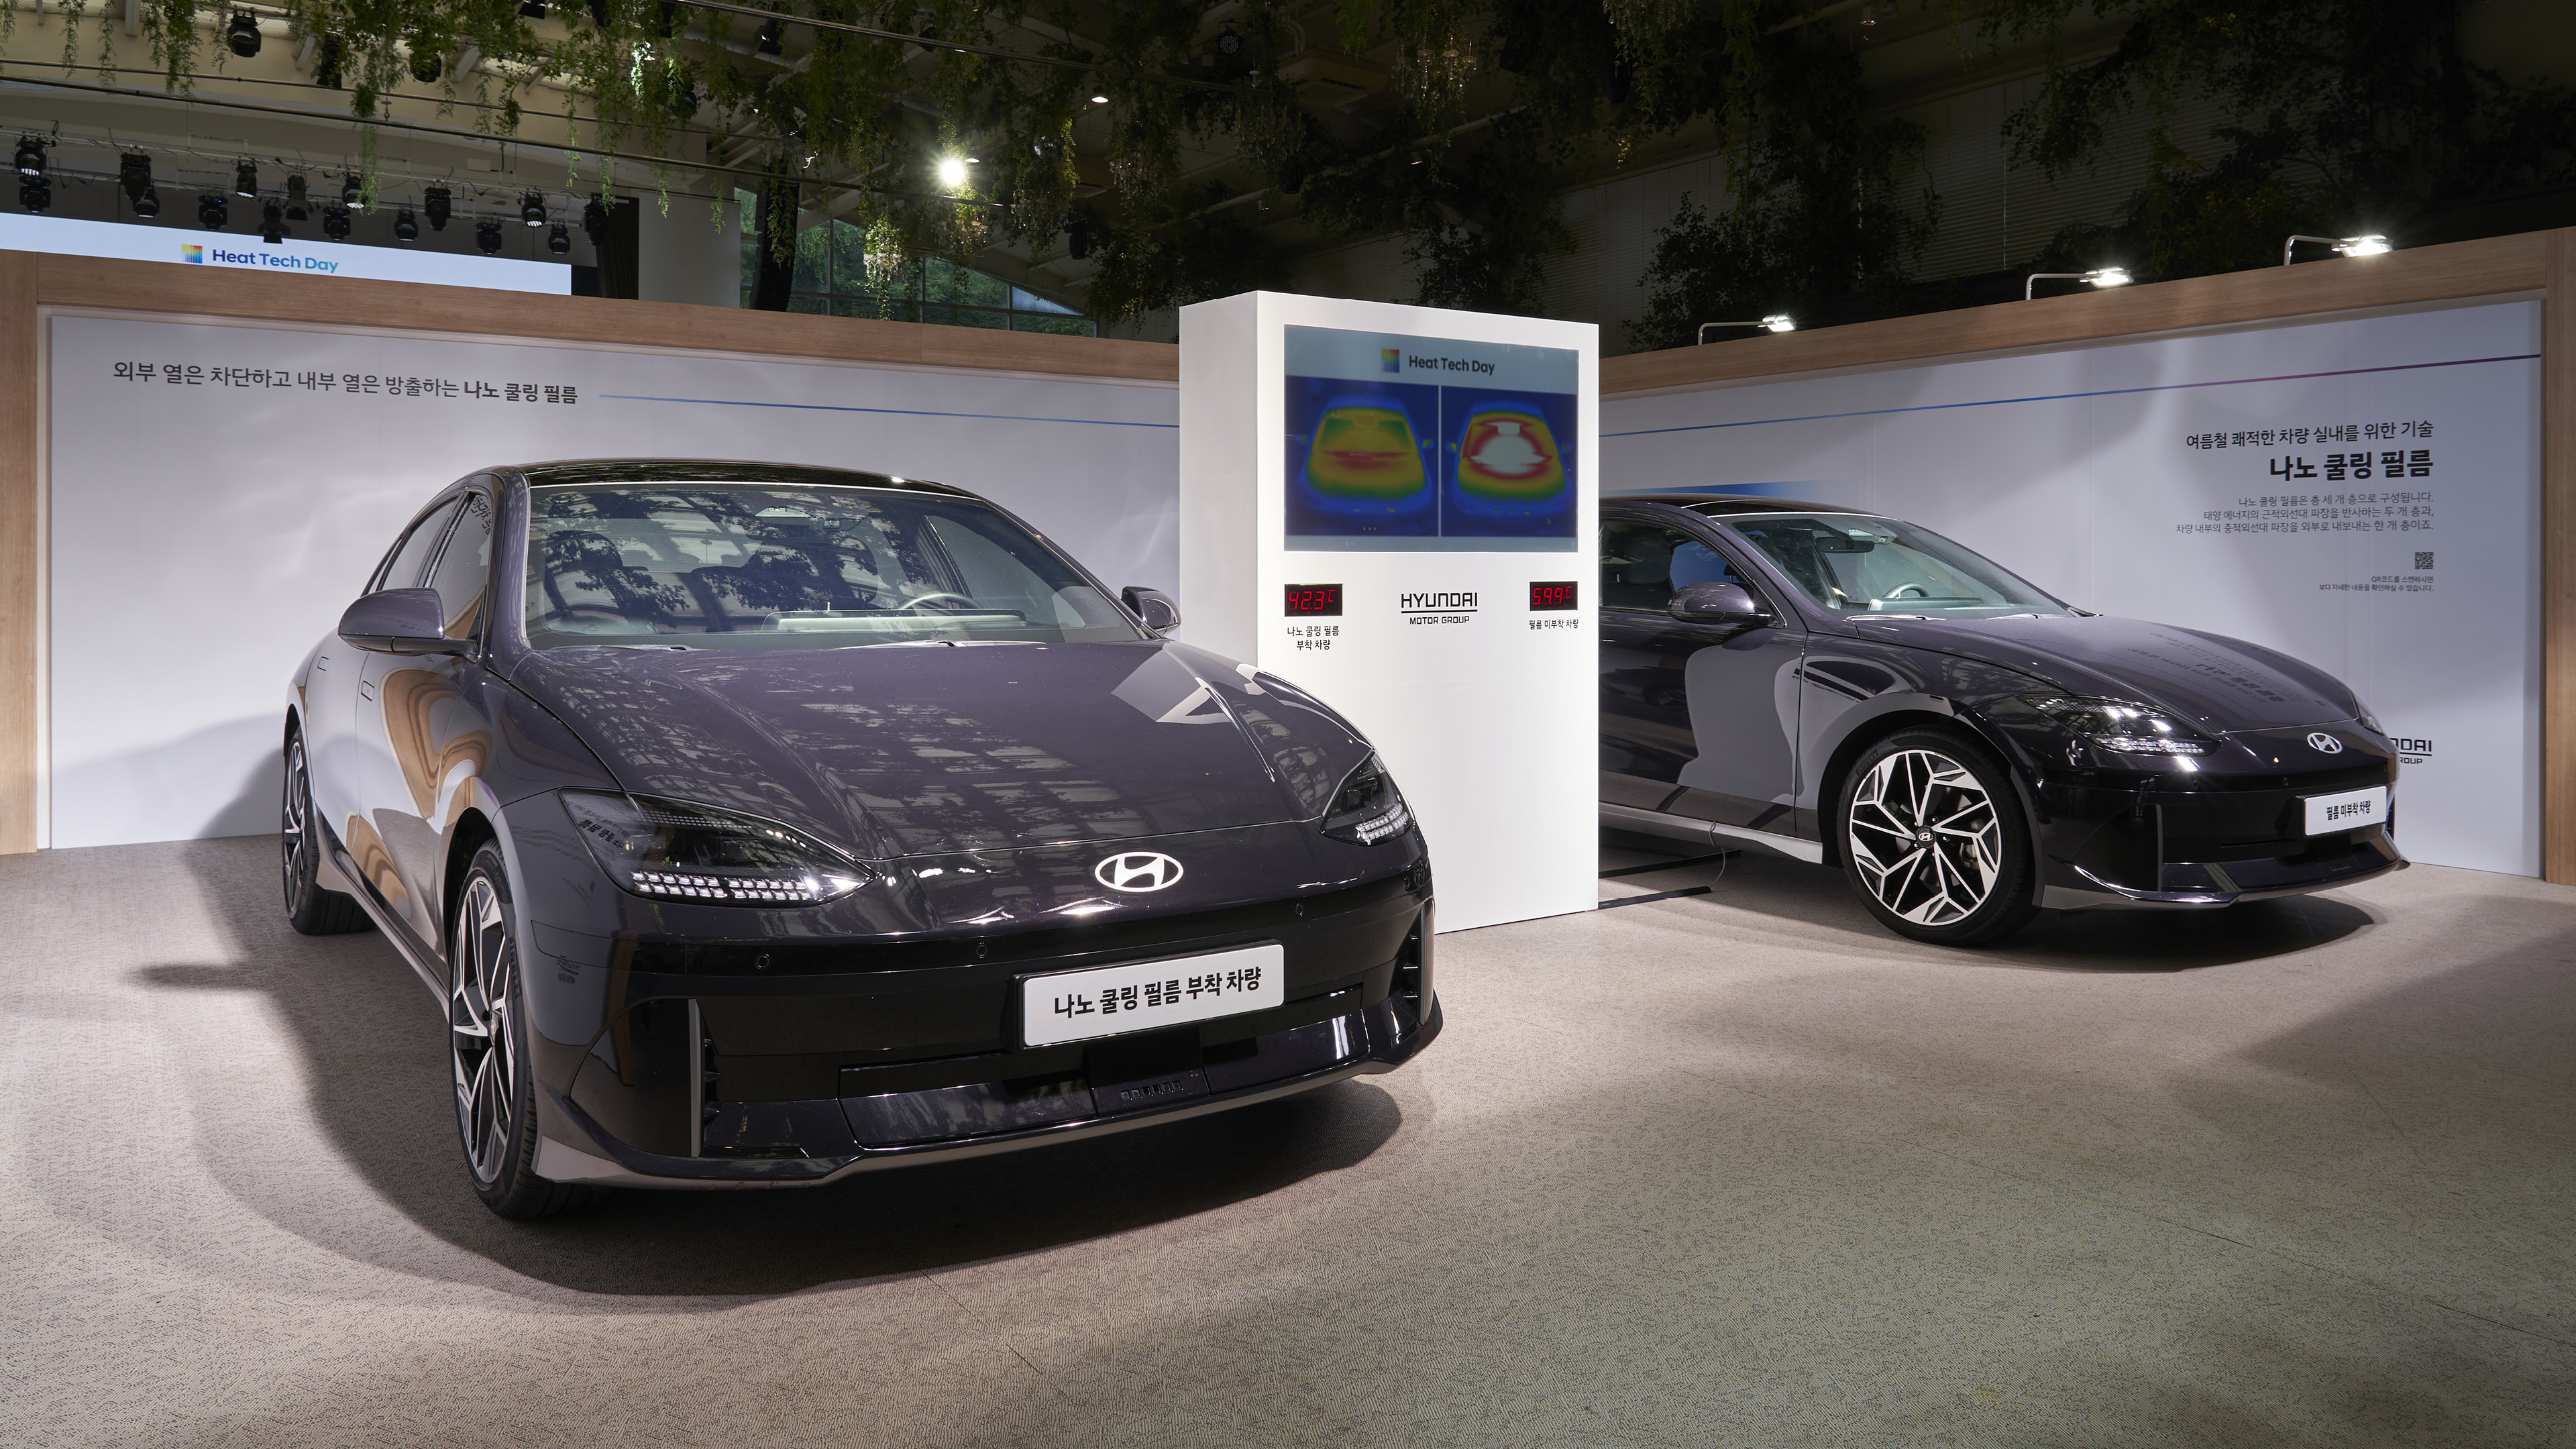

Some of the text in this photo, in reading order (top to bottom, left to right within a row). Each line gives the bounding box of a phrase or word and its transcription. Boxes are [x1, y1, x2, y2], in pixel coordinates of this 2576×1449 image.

[213, 250, 338, 273] Heat Tech Day
[1409, 355, 1495, 376] Heat Tech Day
[113, 362, 578, 404] 외부 열은 차단하고 내부 열은 방출하는 나노 쿨링 필름
[2187, 420, 2434, 449] 여름철 쾌적한 차량 실내를 위한 기술
[2270, 449, 2433, 481] 나노 쿨링 필름
[2239, 492, 2434, 507] 나노 쿨링 필름은 총 세 개 층으로 구성됩니다.
[2204, 505, 2434, 521] 태양 에너지의 근적외선대 파장을 반사하는 두 개 층과,
[2176, 520, 2434, 534] 차량 내부의 중적외선대 파장을 외부로 내보내는 한 개 층이죠.
[2371, 584, 2396, 592] 확인하실
[1401, 592, 1477, 608] HYUNDAI
[1409, 616, 1469, 625] MOTOR GROUP
[1529, 619, 1578, 630] 필름 미부착 차량
[1287, 625, 1339, 637] 나노 쿨링 필름
[1296, 639, 1330, 651] 부착 차량
[2326, 800, 2371, 820] 필름 미부착 차량
[1055, 966, 1261, 1018] 나노 쿨링 필름 부착 차량
